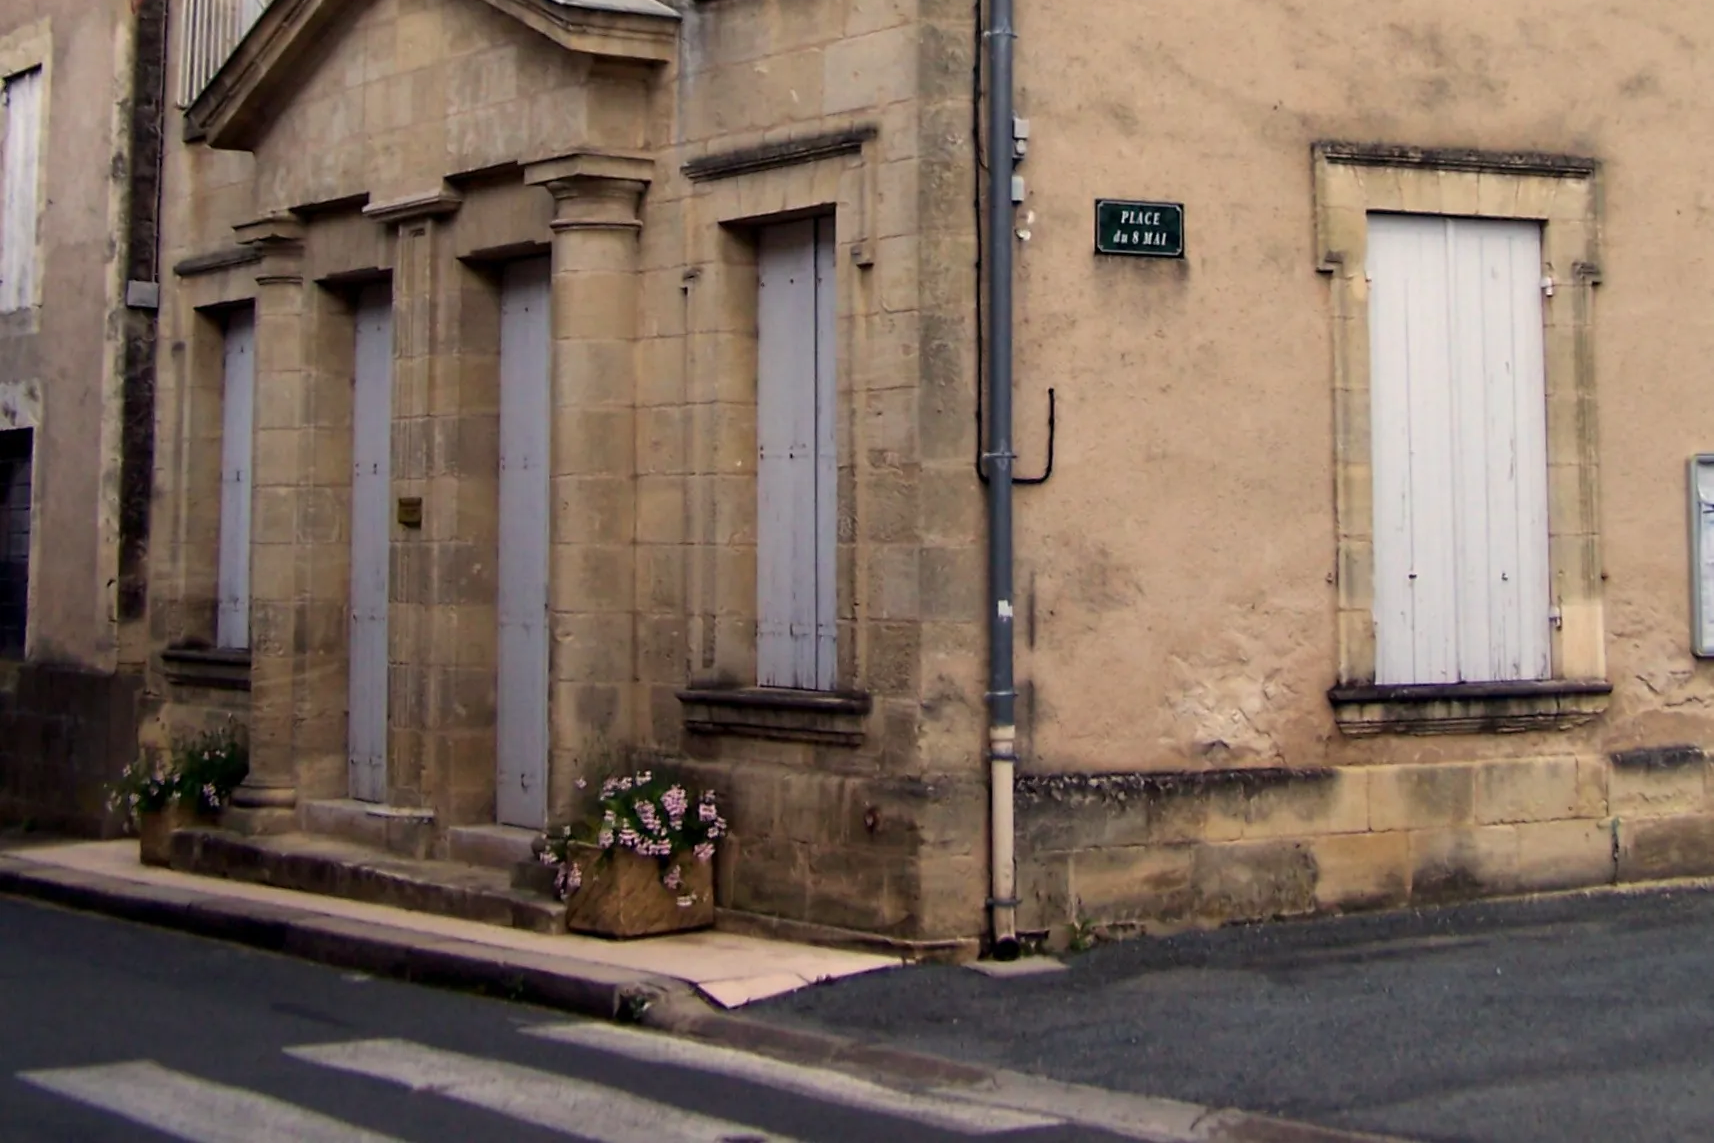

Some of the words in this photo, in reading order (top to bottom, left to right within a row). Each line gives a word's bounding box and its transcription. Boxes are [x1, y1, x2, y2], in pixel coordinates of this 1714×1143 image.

[1121, 210, 1161, 225] PLACE
[1113, 230, 1128, 244] du
[1132, 231, 1140, 245] 8
[1142, 231, 1167, 246] MAI
